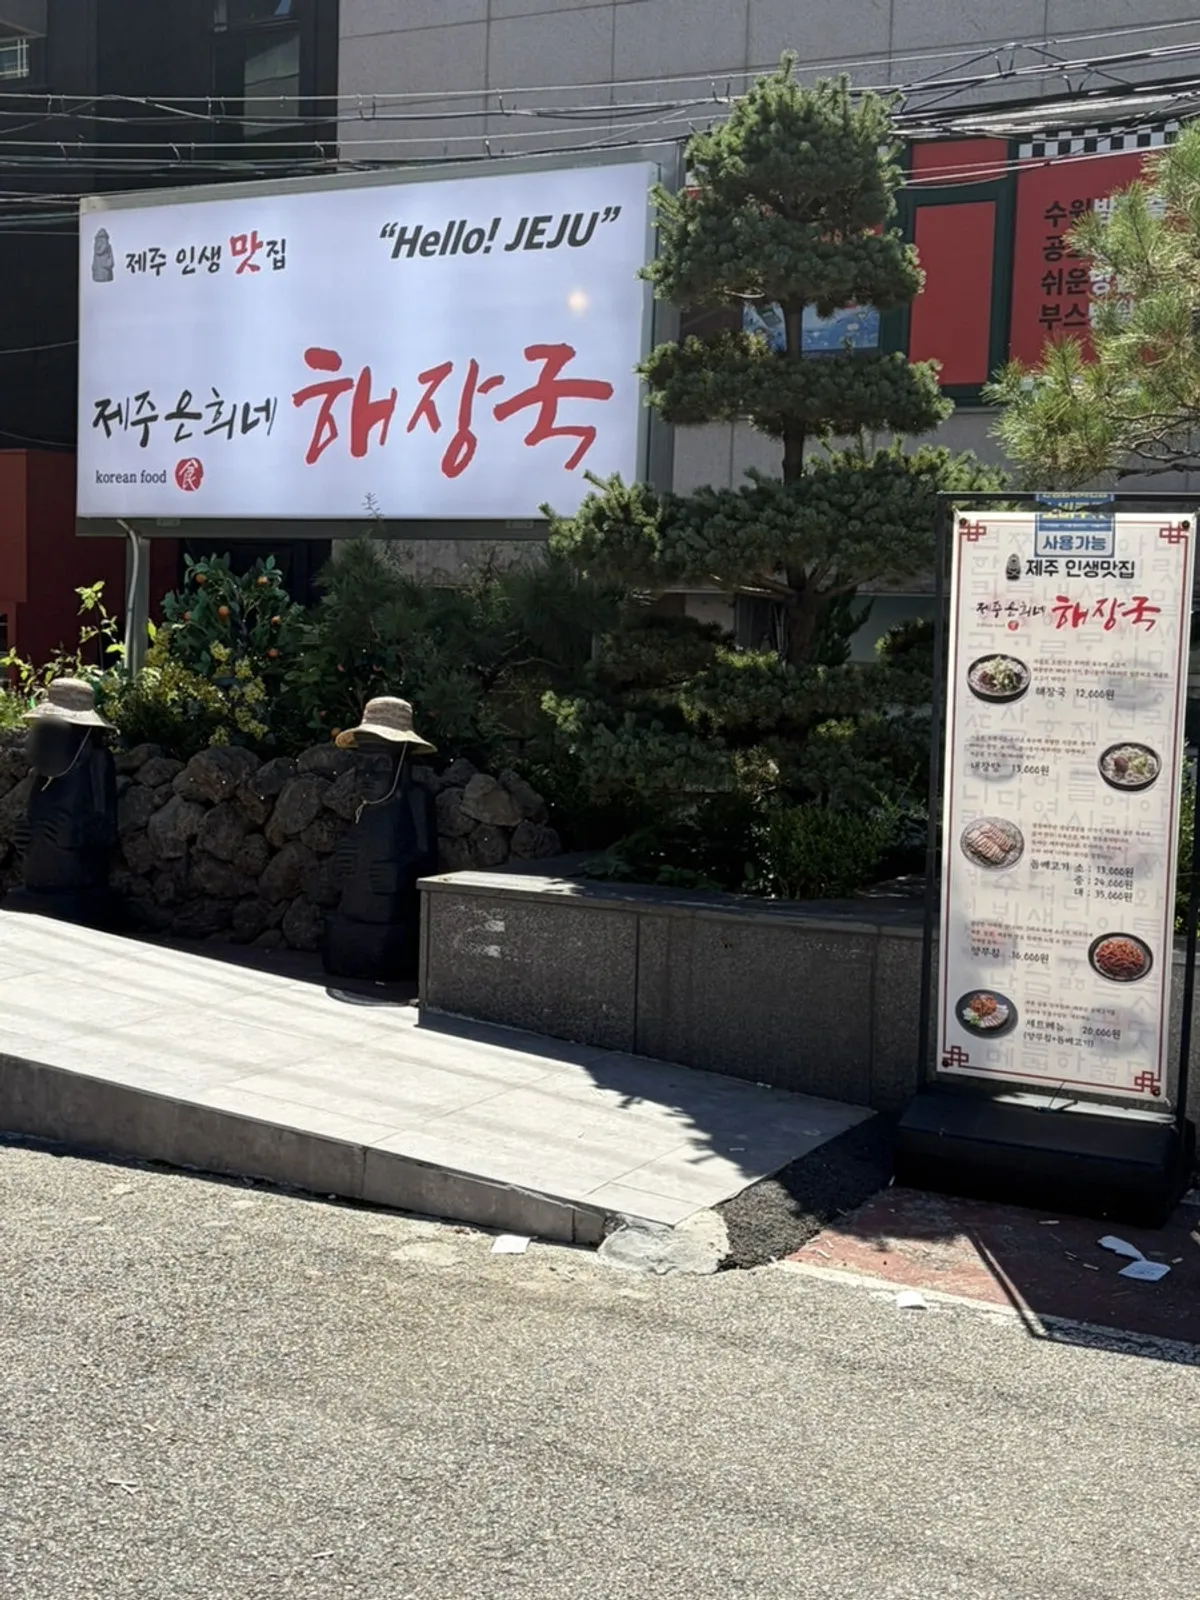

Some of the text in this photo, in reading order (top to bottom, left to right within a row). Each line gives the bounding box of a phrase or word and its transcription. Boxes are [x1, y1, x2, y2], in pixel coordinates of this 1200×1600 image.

[125, 230, 287, 277] 제주 인생 맛집
[291, 342, 615, 479] 해장국
[95, 469, 167, 483] korean food
[1042, 535, 1106, 551] 사용가능
[1025, 559, 1135, 579] 제주 인생맛집
[1051, 595, 1161, 632] 해장국
[1035, 686, 1067, 698] 해장국
